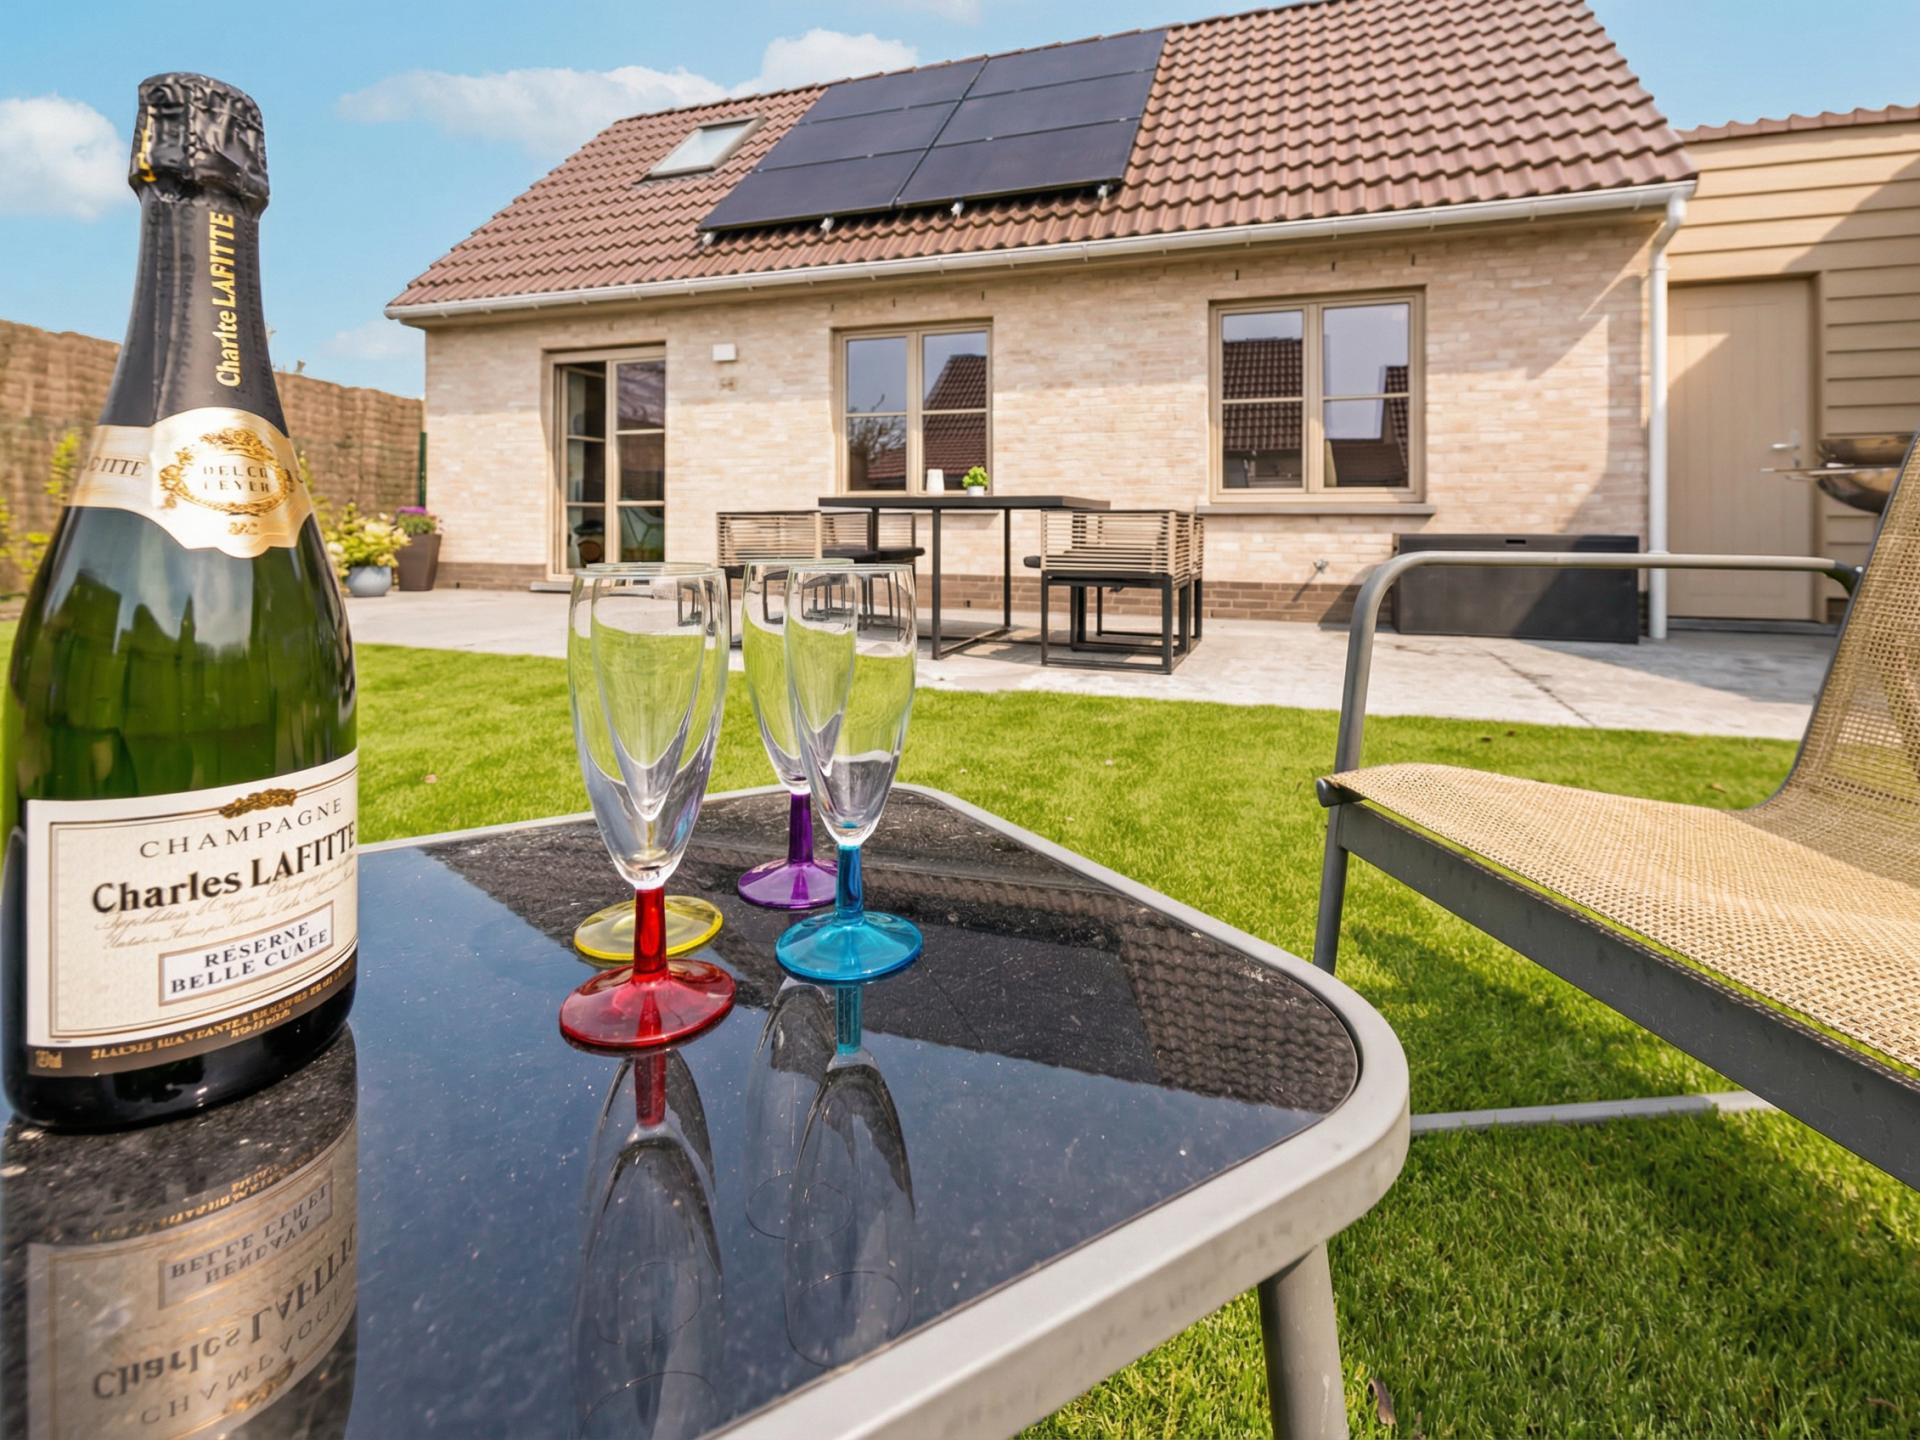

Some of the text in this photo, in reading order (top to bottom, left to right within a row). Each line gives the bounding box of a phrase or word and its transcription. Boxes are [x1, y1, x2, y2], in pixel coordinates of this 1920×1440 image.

[209, 211, 236, 308] LAFITTE
[92, 870, 242, 914] Charles
[250, 820, 355, 888] LAFITTE
[139, 797, 342, 859] CHAMPAGNE
[171, 959, 256, 995] BELLE
